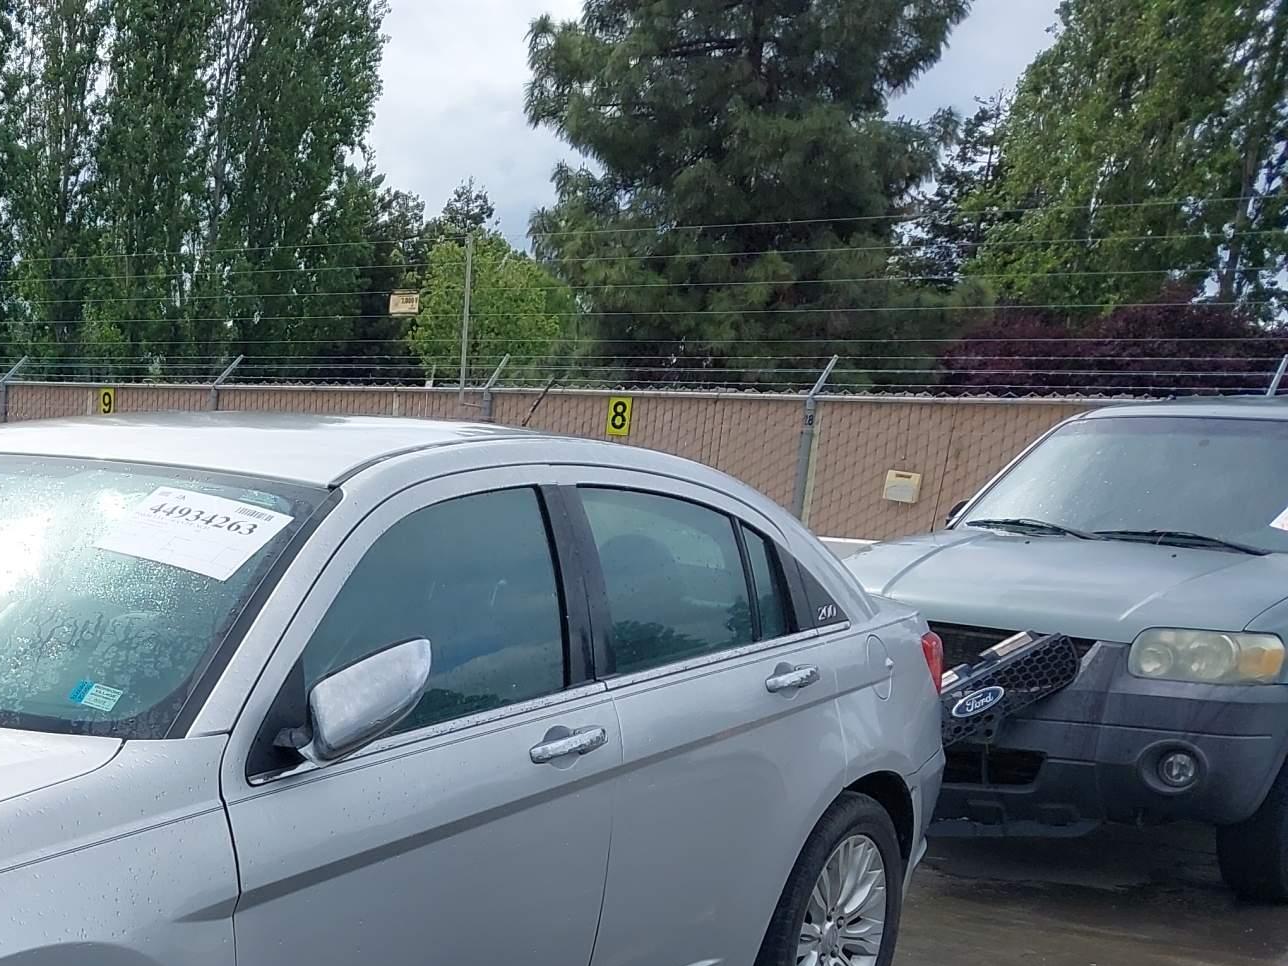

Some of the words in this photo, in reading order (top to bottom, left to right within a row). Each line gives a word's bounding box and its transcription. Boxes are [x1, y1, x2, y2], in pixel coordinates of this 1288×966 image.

[102, 391, 112, 414] 9
[611, 400, 627, 430] 8
[149, 502, 258, 536] 44934263
[965, 692, 994, 712] Ford
